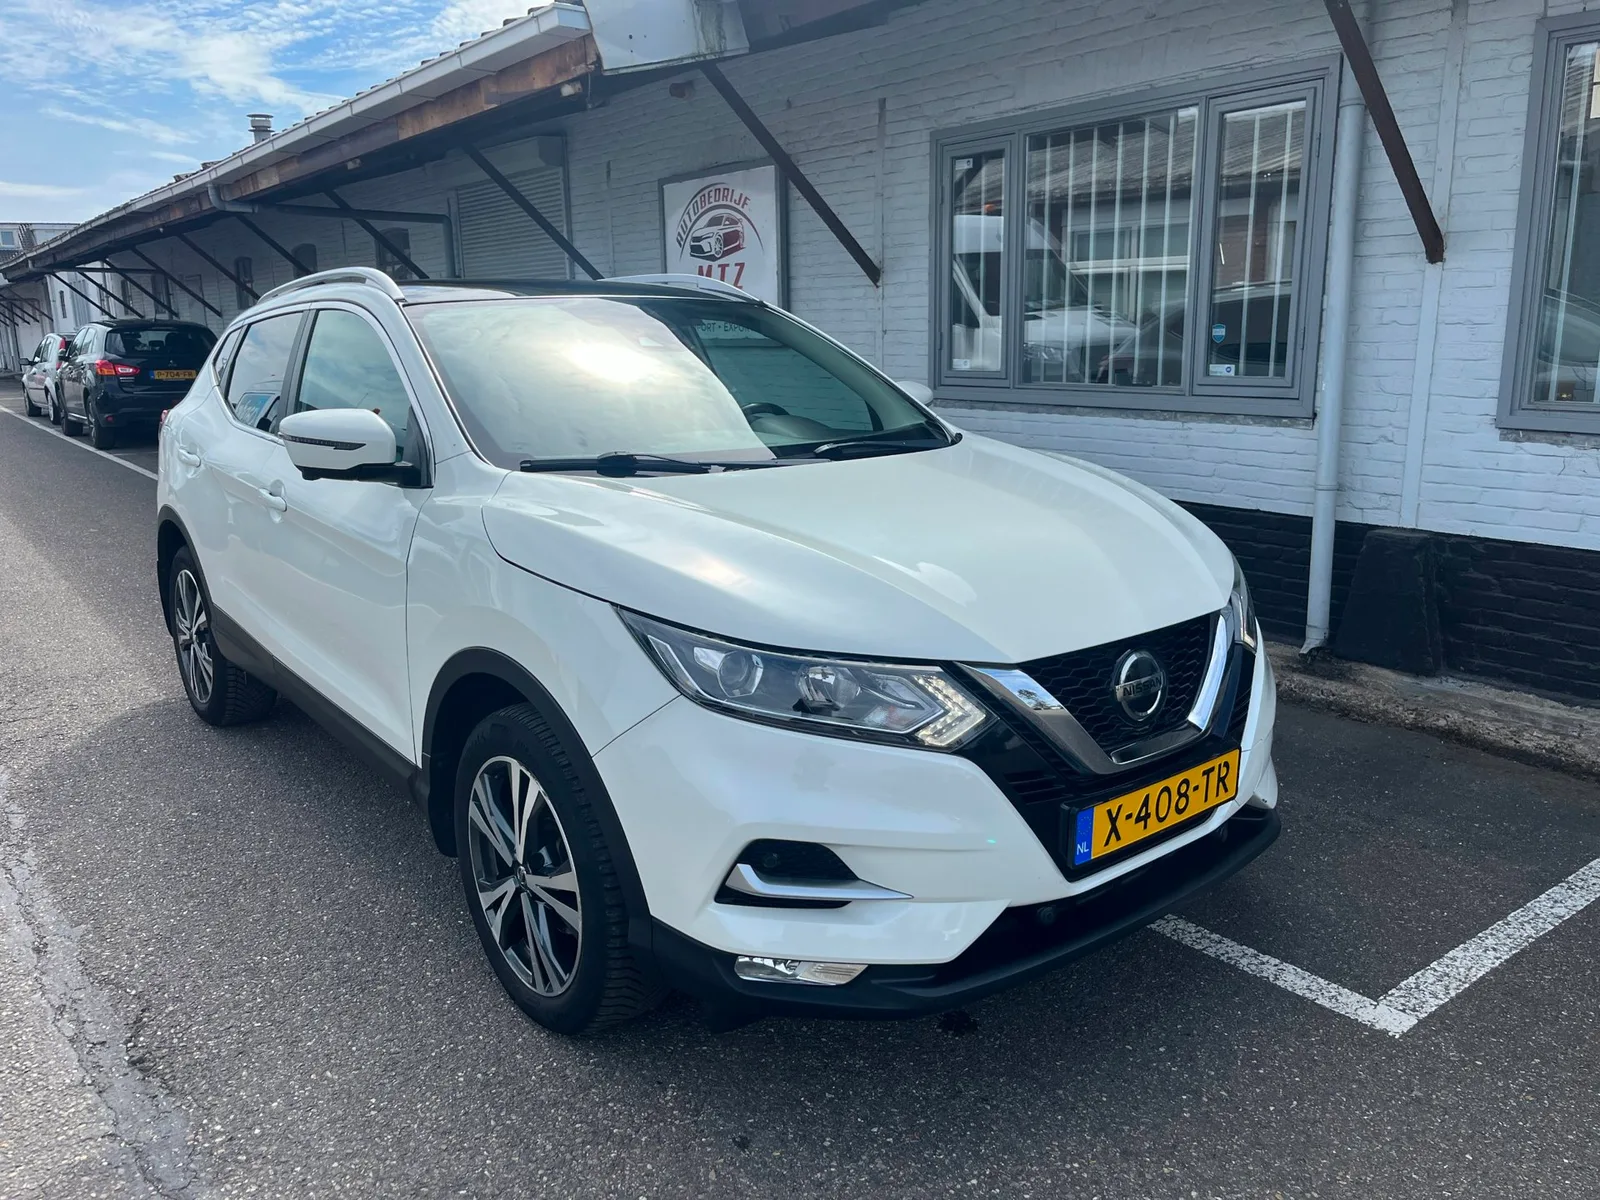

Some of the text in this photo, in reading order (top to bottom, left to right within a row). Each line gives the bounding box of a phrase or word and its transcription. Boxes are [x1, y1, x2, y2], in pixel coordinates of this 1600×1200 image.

[676, 187, 751, 248] AUTOBEDRIJF
[698, 262, 746, 289] MTZ
[156, 371, 194, 379] P-704-FR
[1123, 676, 1161, 697] NISSAN
[1077, 761, 1230, 855] NL X-408-TR
